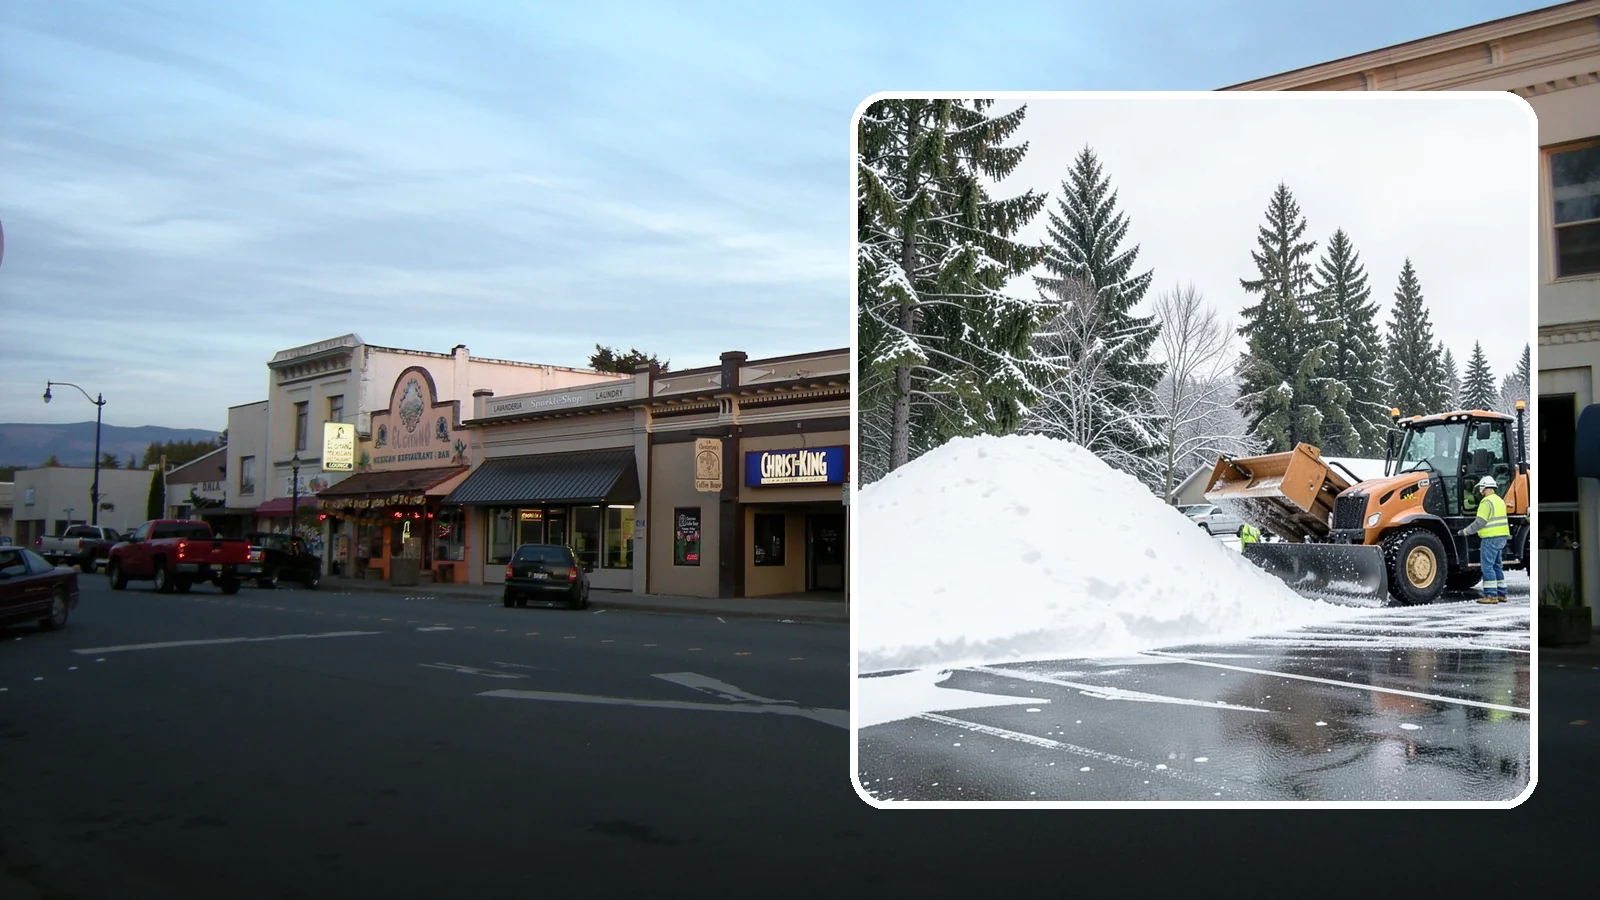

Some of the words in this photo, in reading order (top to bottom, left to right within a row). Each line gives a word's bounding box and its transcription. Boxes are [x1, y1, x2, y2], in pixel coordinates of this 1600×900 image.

[595, 389, 623, 400] LAUNDRY
[493, 402, 522, 413] LAVANDERIA
[531, 398, 560, 409] Sparkle
[561, 394, 582, 406] Shop
[373, 454, 396, 464] MEXICAN
[397, 451, 433, 462] RESTAURANT
[438, 450, 450, 459] BAR
[761, 452, 797, 478] CHRIST
[799, 450, 827, 476] KING
[696, 481, 709, 489] Coffee
